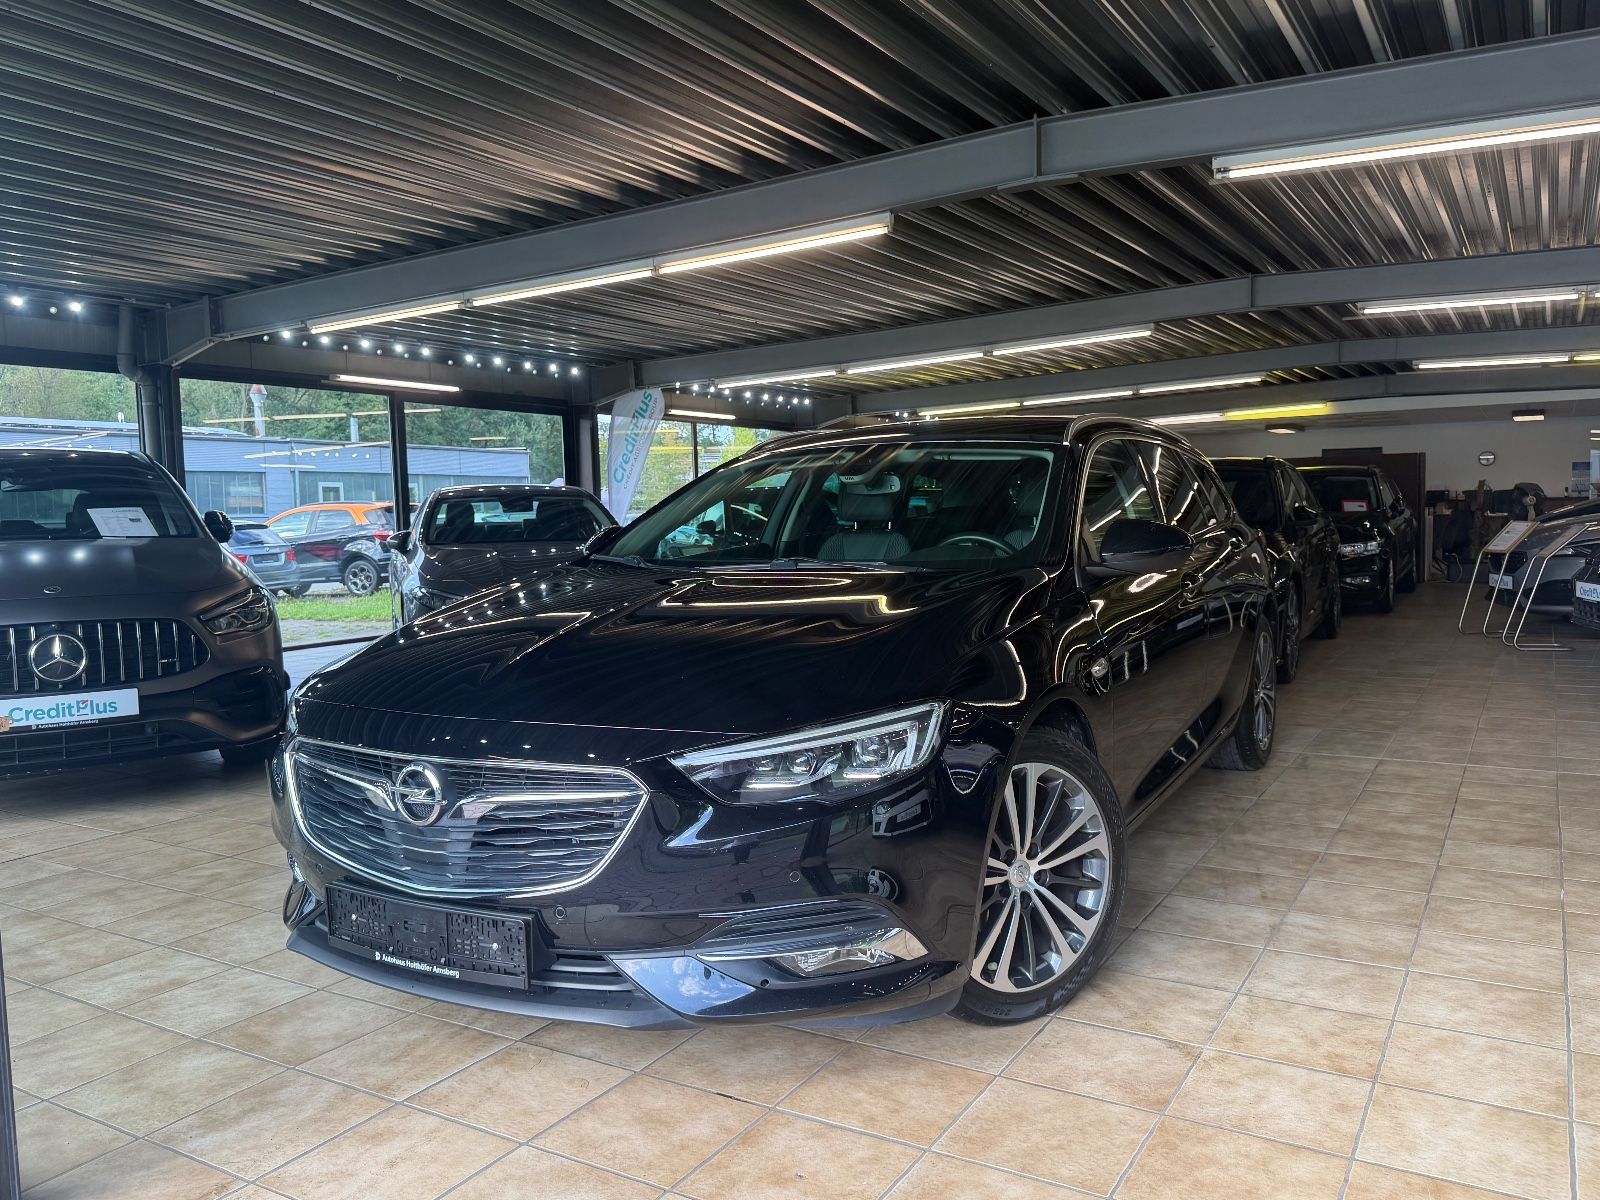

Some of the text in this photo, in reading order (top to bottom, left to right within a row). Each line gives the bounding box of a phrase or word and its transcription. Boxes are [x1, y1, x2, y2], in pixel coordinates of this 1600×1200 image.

[8, 699, 118, 723] CreditPlus
[382, 953, 460, 978] Autohaus Holthöfer Arnsberg
